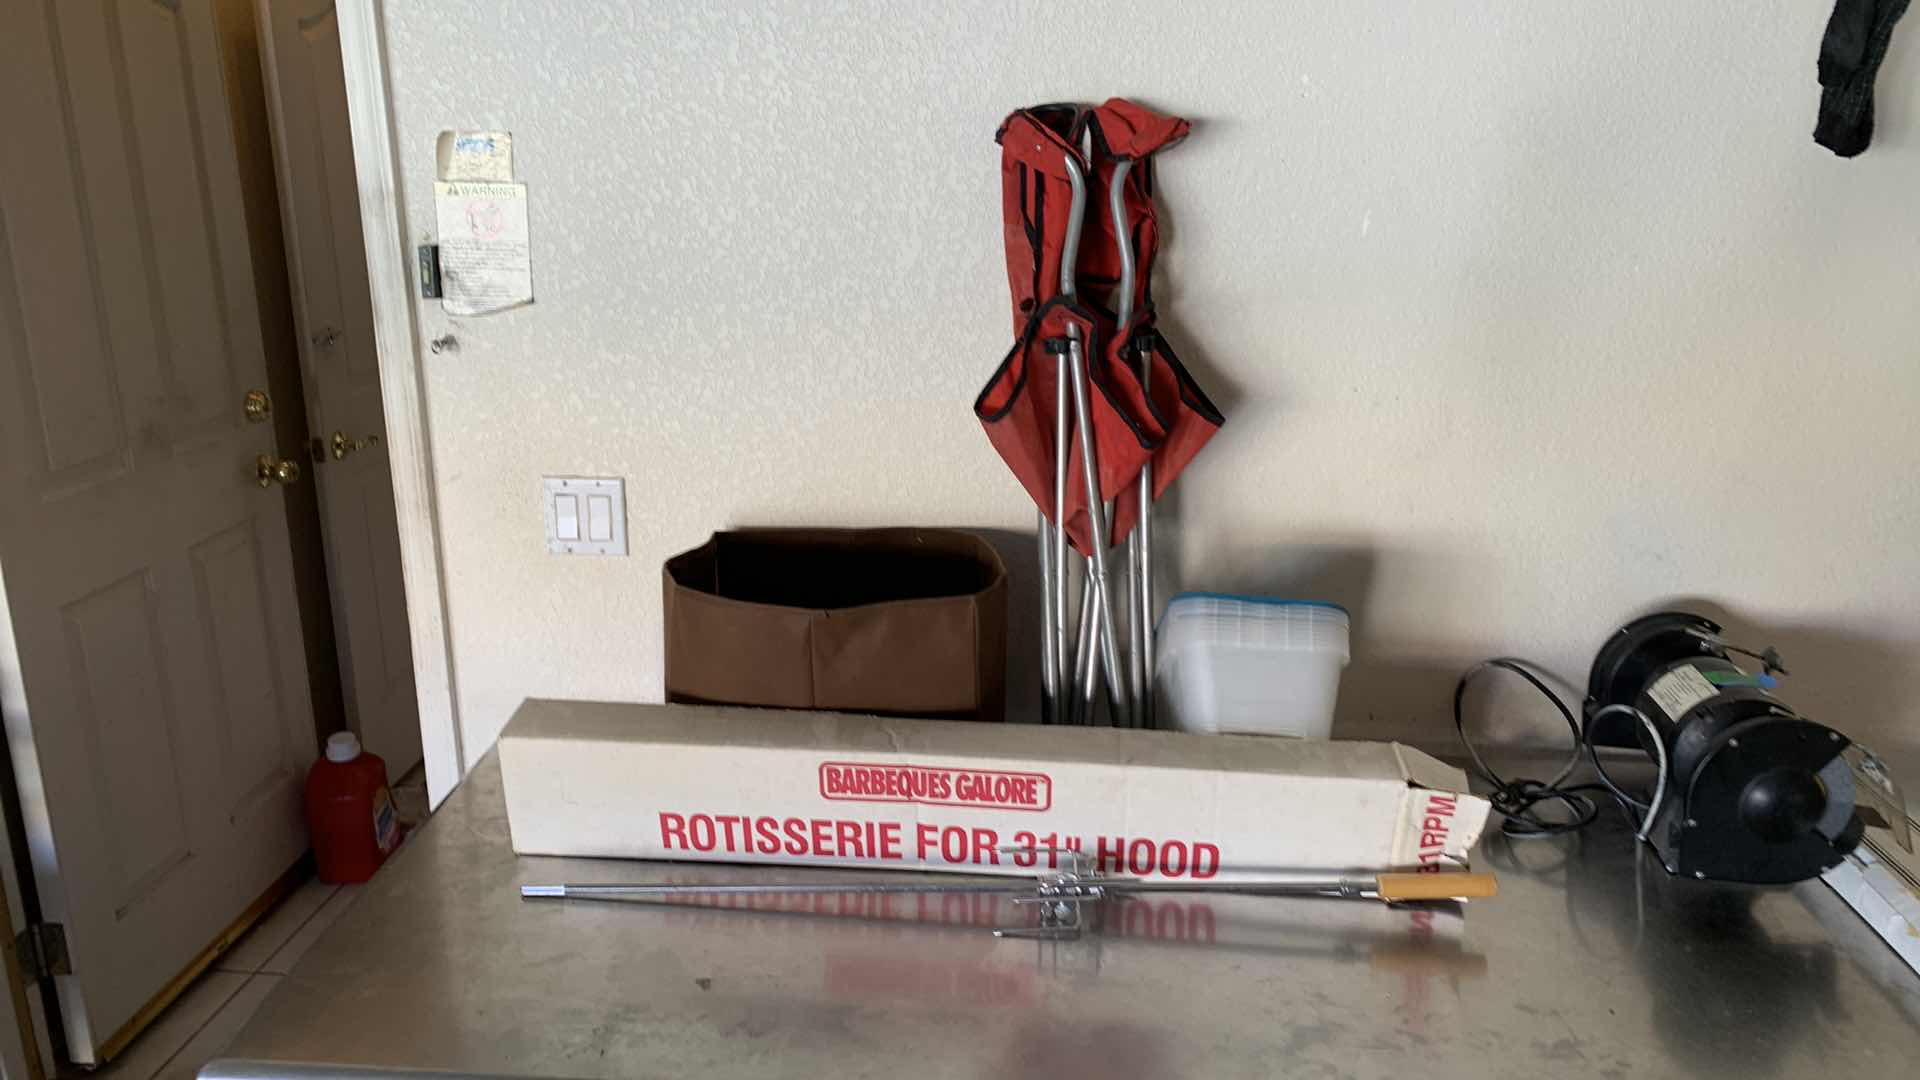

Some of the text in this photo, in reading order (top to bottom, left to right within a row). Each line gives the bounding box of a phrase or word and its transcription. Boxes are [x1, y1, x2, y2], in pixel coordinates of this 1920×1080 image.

[460, 184, 517, 198] WARNING
[826, 767, 1038, 804] BARBEQUES GALORE
[659, 812, 903, 859] ROTISSERIE
[916, 823, 1000, 865] FOR
[1096, 836, 1220, 879] HOOD
